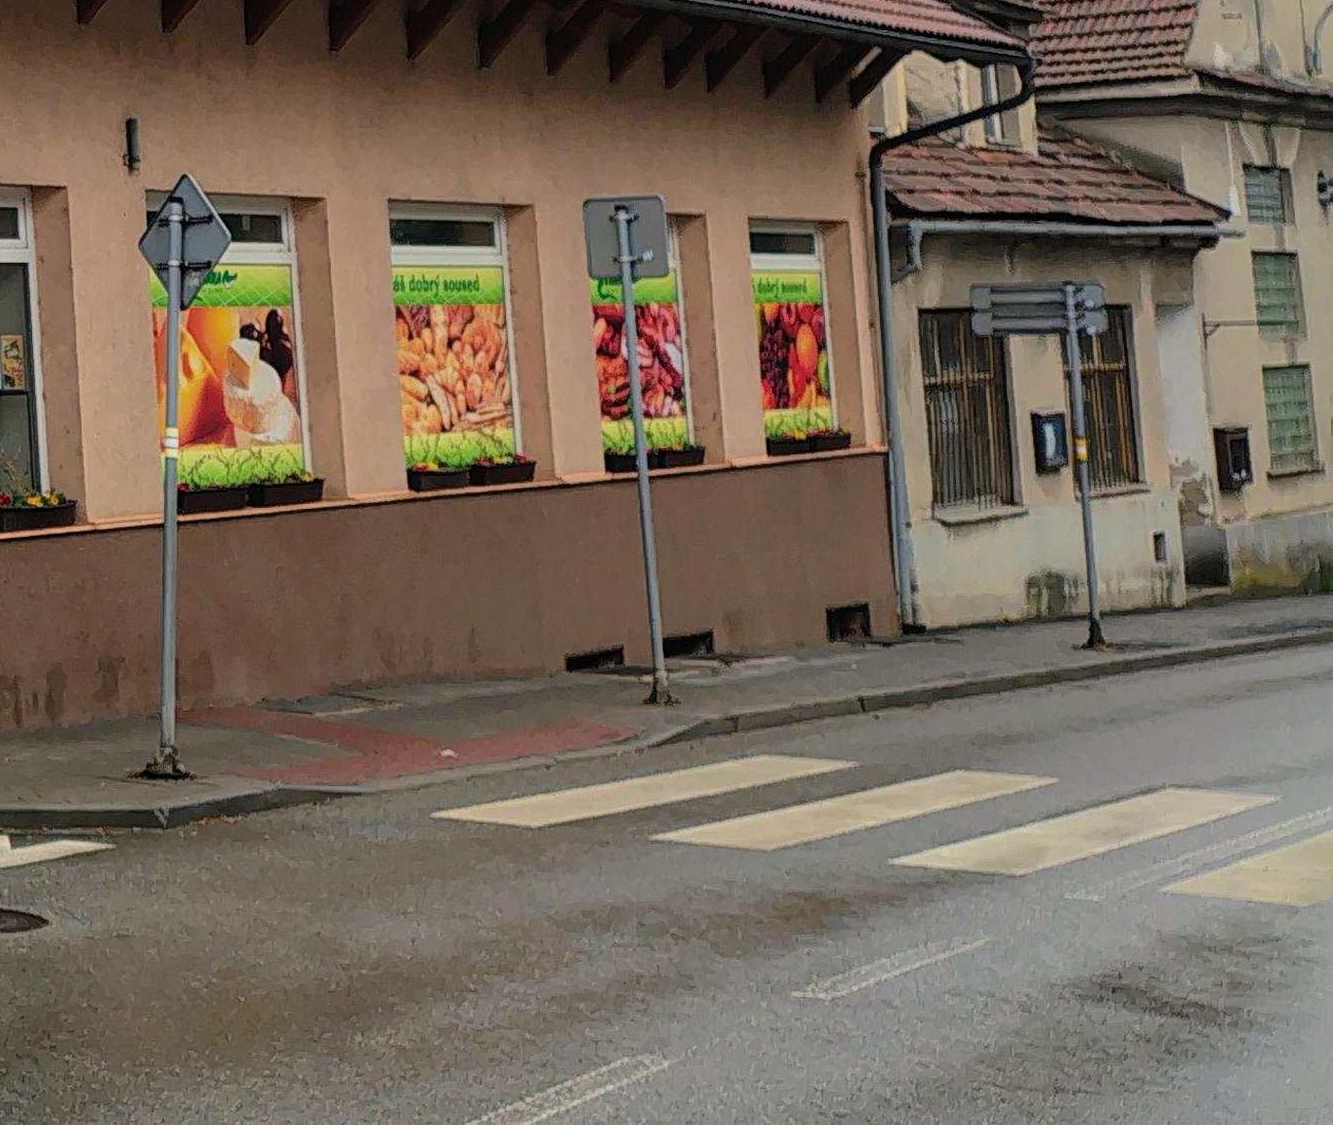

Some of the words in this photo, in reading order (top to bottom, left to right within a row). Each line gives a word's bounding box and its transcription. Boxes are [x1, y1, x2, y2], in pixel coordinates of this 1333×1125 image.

[393, 273, 405, 292] áš
[409, 274, 439, 300] dobrý
[443, 273, 480, 293] soused
